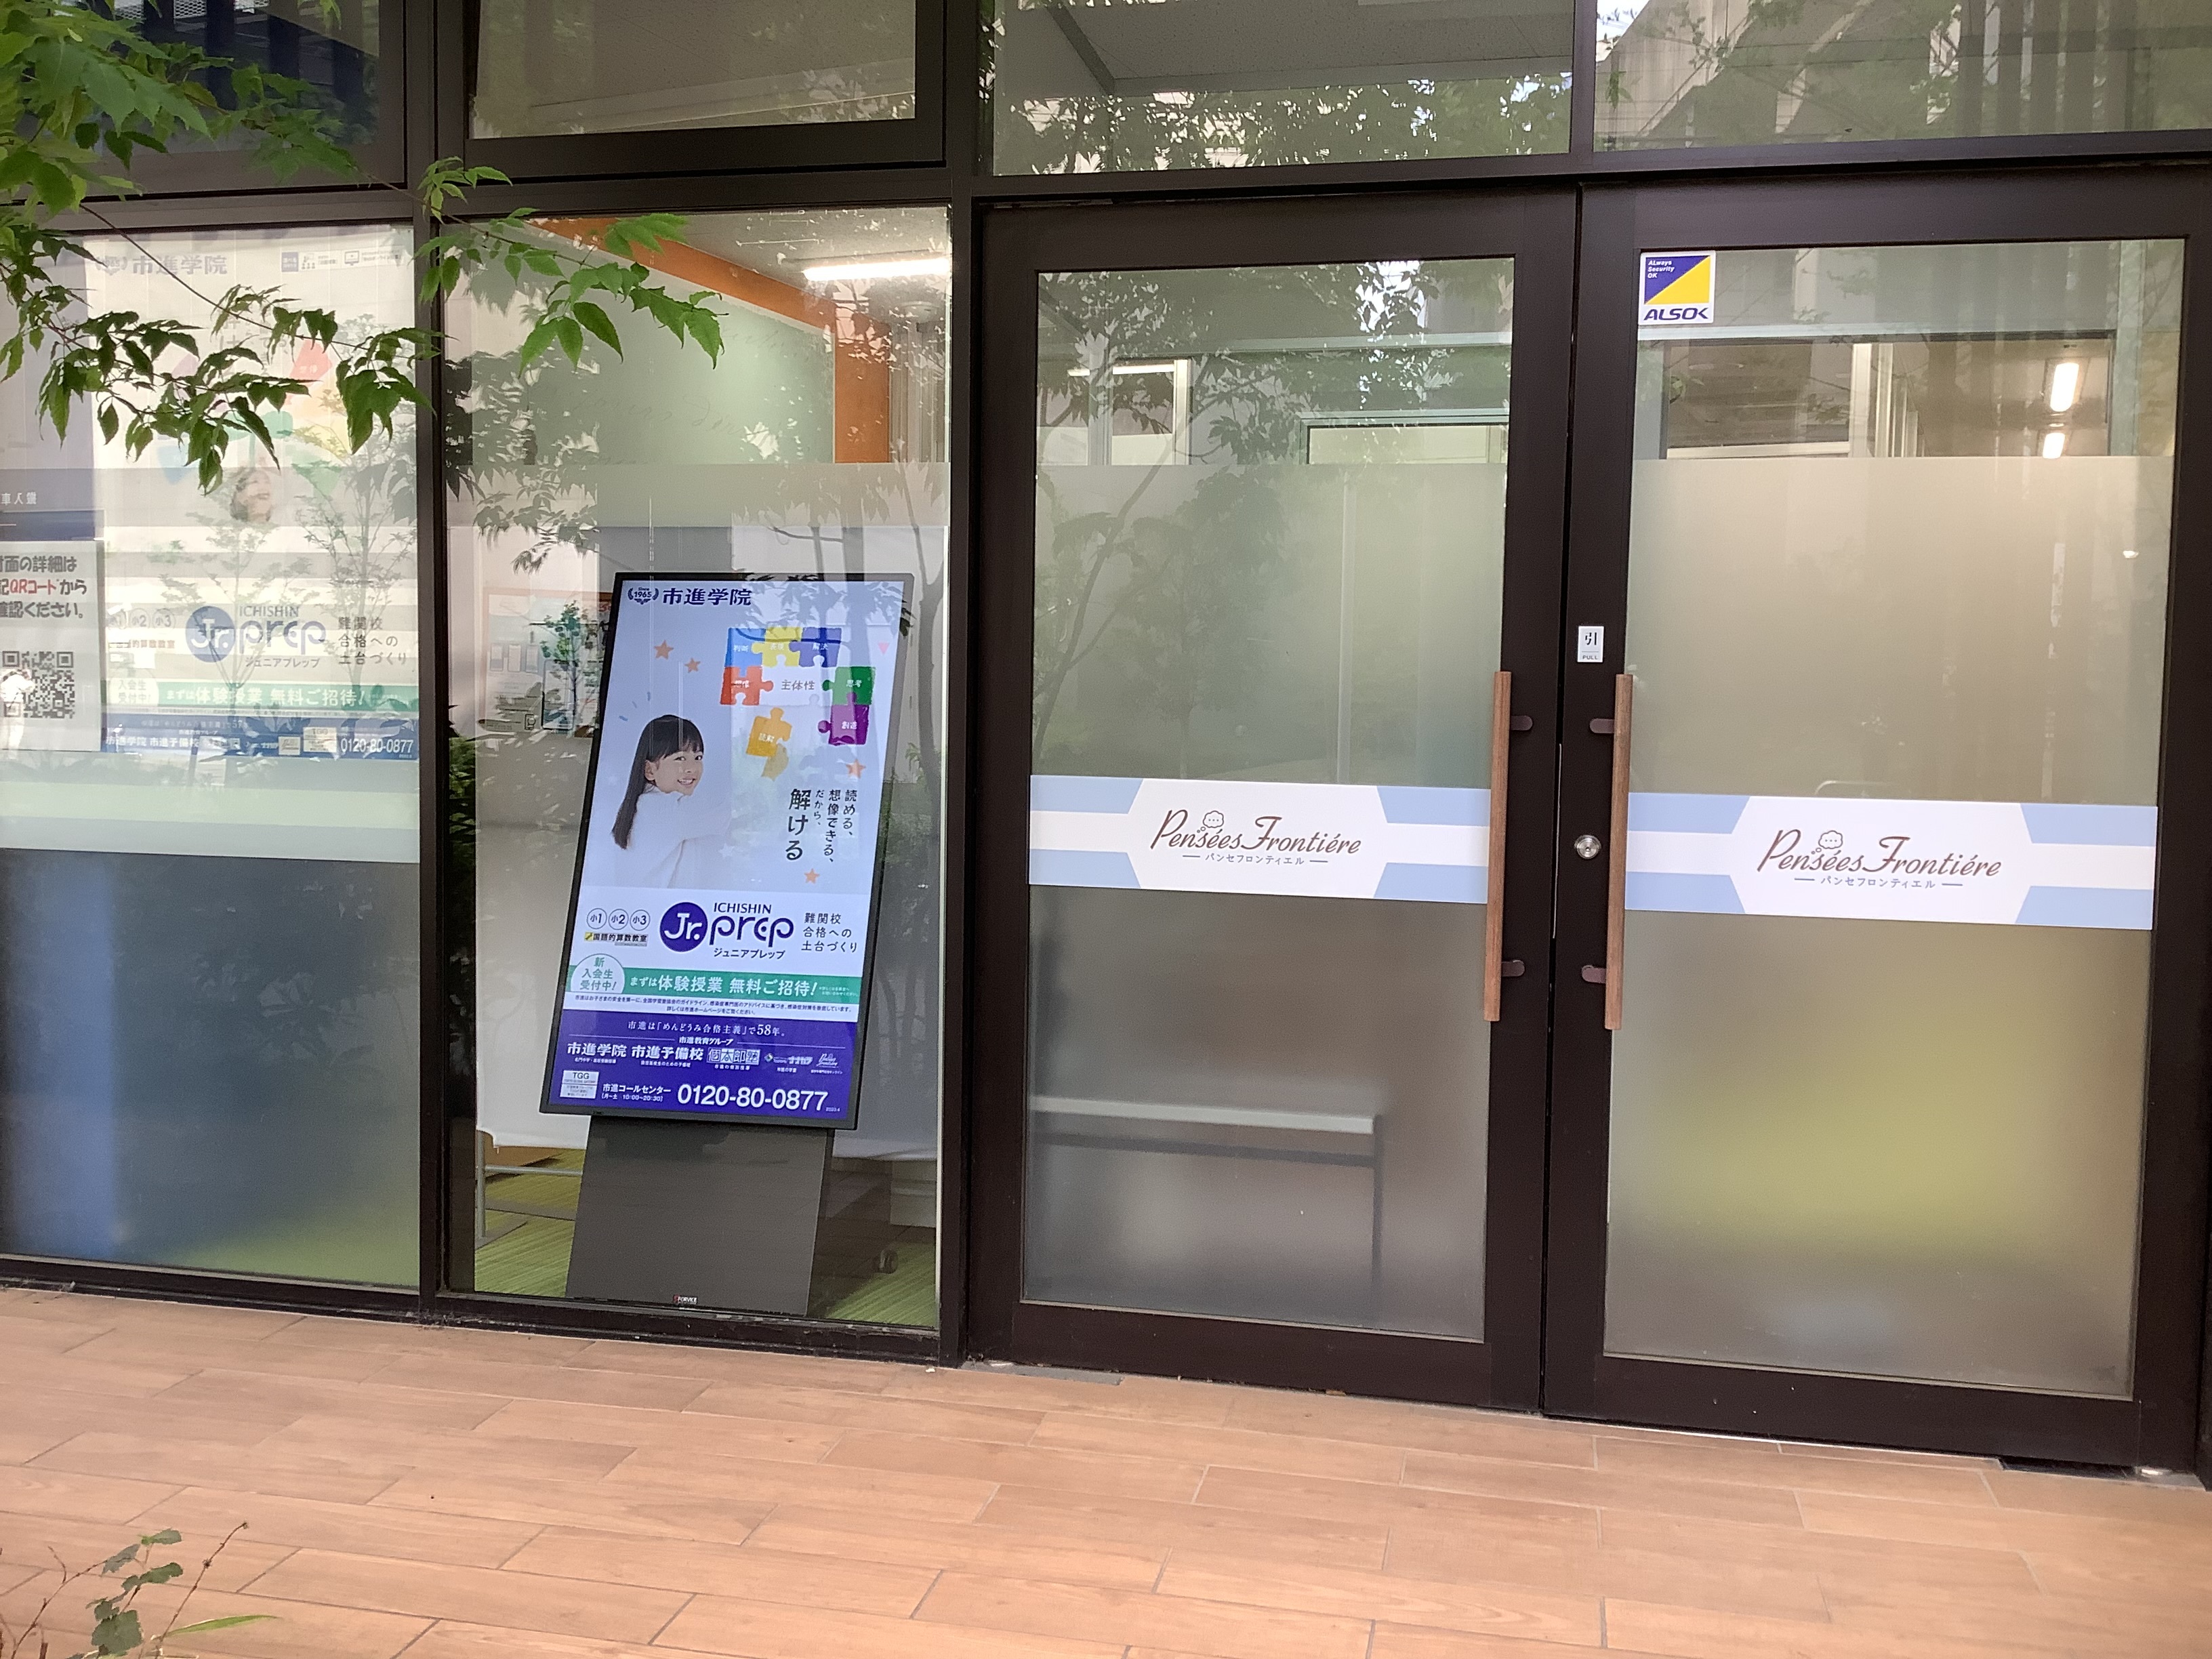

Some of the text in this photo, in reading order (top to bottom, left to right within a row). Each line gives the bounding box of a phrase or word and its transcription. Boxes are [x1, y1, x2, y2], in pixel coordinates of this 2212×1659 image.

[132, 255, 228, 274] 市進学院
[1643, 308, 1708, 321] ALSOK
[663, 588, 752, 606] 市進学院
[239, 606, 299, 617] ICHISHIN
[155, 615, 171, 628] 小3
[338, 617, 383, 630] 難関校
[190, 618, 229, 649] Jr.
[240, 619, 327, 655] prep
[1585, 632, 1597, 645] 引
[338, 634, 398, 648] 合格への
[245, 657, 320, 668] ジュニアプレップ
[338, 651, 407, 665] 土台づくり
[118, 679, 147, 691] 入会生
[781, 680, 815, 691] 主体性
[271, 689, 365, 706] 無料ご招待!
[841, 721, 858, 730] 創造
[340, 738, 414, 754] 0120-80-0877
[814, 790, 825, 825] だから、
[842, 790, 857, 835] 読める、
[785, 788, 812, 861] 解ける
[823, 789, 841, 862] 想像できる、
[1205, 853, 1305, 865] パンセフロンティエル
[1820, 877, 1936, 889] パンセフロンティエル
[713, 902, 772, 914] ICHISHIN
[590, 913, 602, 924] 小1
[611, 914, 626, 924] 小2
[632, 915, 647, 925] 小3
[803, 913, 842, 924] 難関校
[664, 912, 702, 941] Jr.
[709, 916, 794, 947] prep
[802, 926, 853, 938] 合格への
[713, 947, 786, 960] ジュニアプレップ
[801, 942, 858, 953] 土台づくり
[594, 957, 605, 968] 新
[581, 968, 613, 979] 入会生
[579, 979, 617, 991] 受付中!
[630, 975, 818, 997] まずは体験授業 無料ご招待!
[679, 1036, 734, 1046] 市進教育グループ
[567, 1042, 627, 1058] 市進学院
[631, 1044, 704, 1061] 市進予備校
[602, 1084, 672, 1094] 市進コールセンター
[678, 1084, 829, 1111] 0120-80-0877
